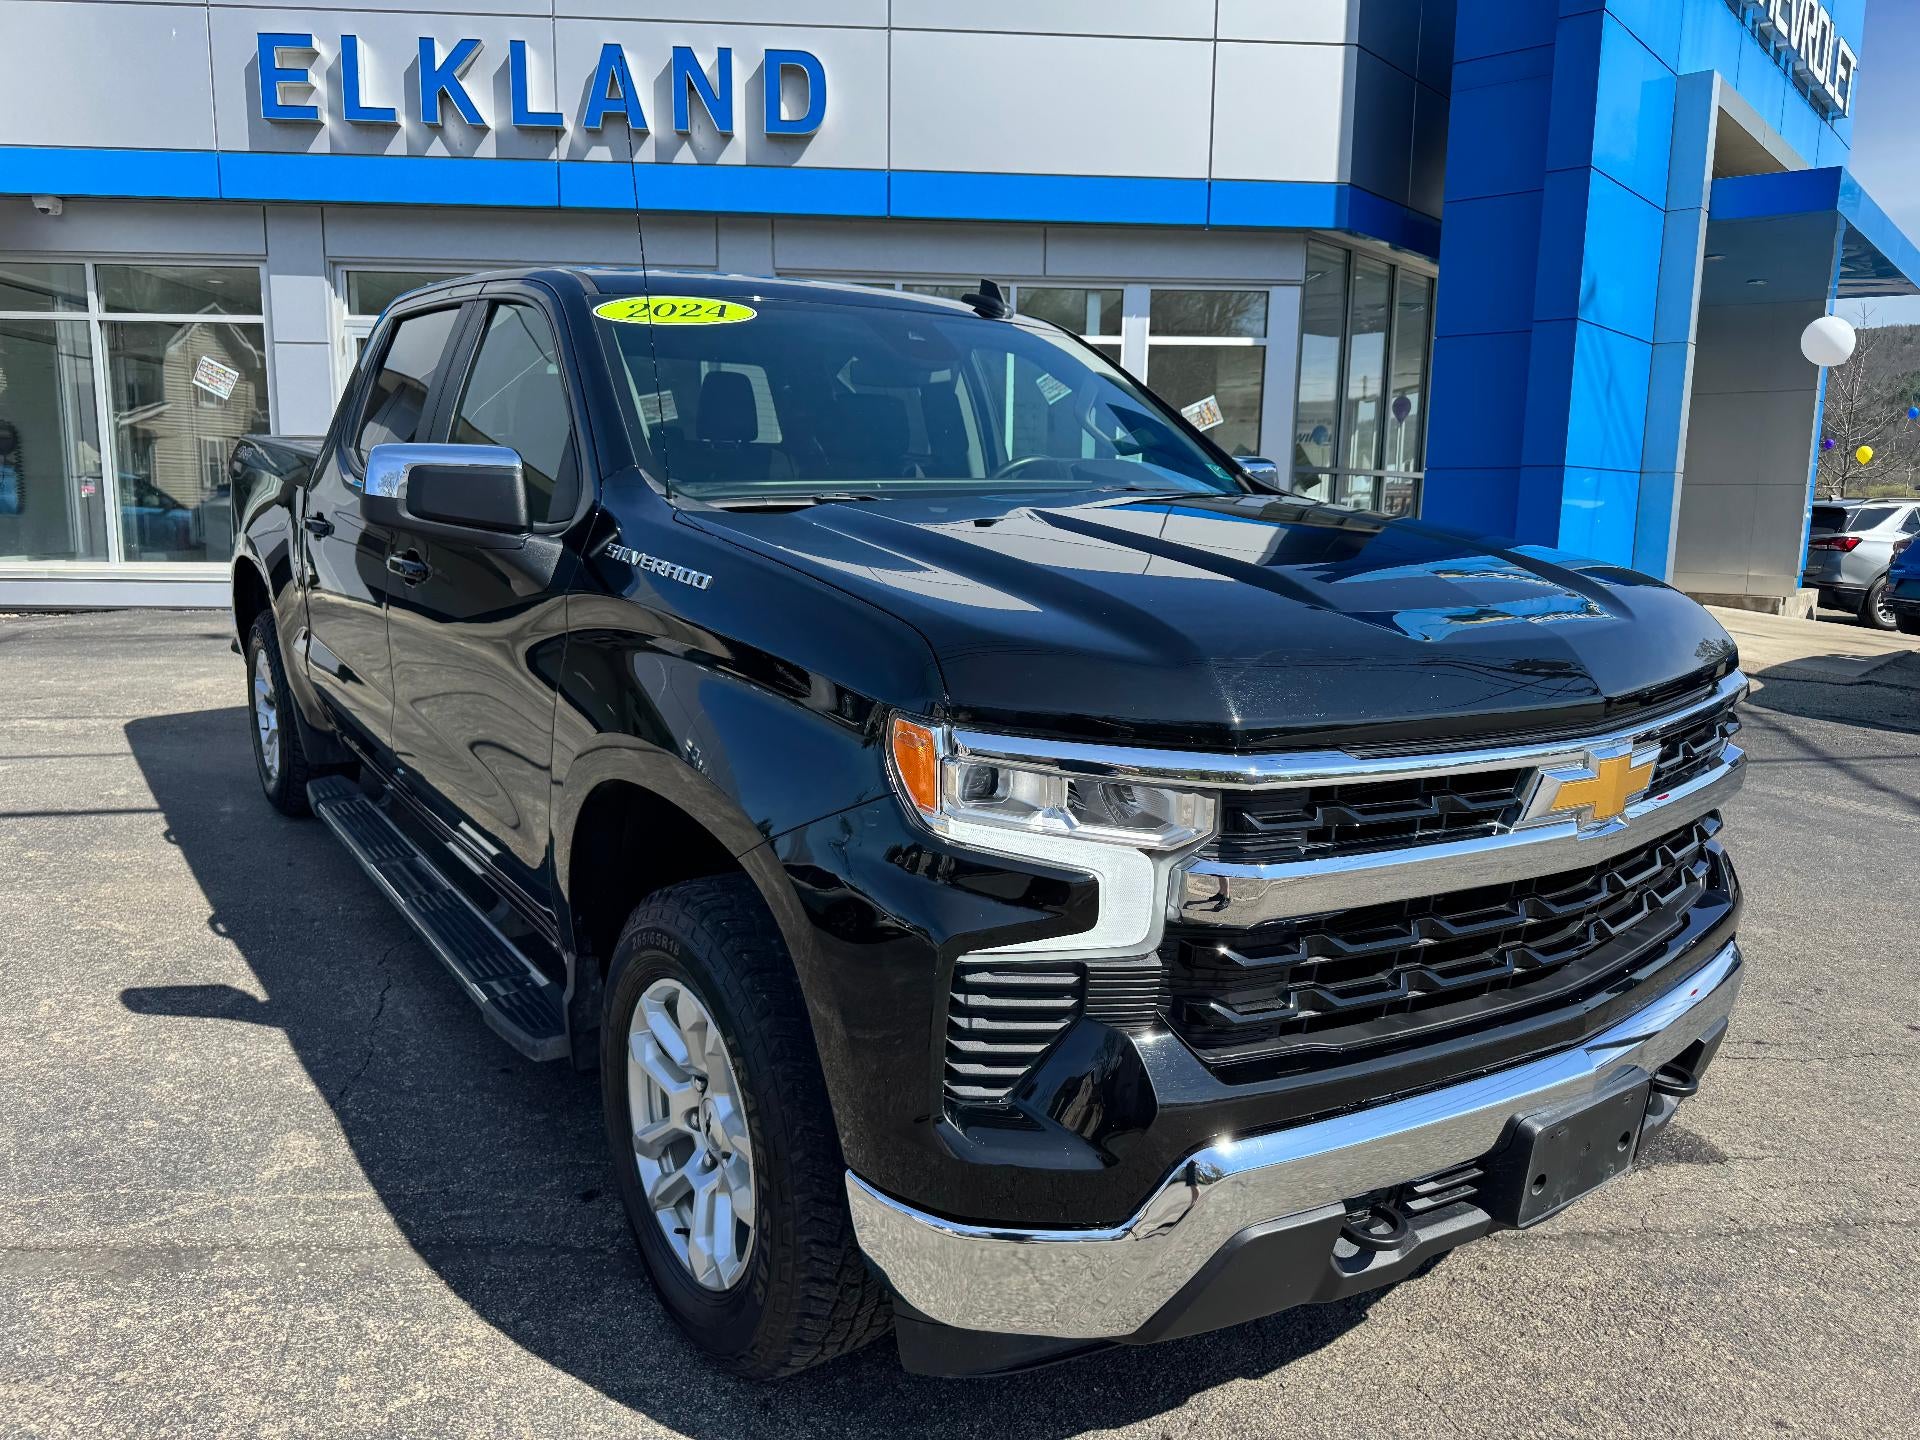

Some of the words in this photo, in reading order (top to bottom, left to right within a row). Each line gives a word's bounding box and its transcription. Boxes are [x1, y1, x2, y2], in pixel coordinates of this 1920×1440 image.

[256, 32, 827, 136] ELKLAND
[625, 302, 728, 318] 2024
[604, 542, 713, 590] SILVERADO
